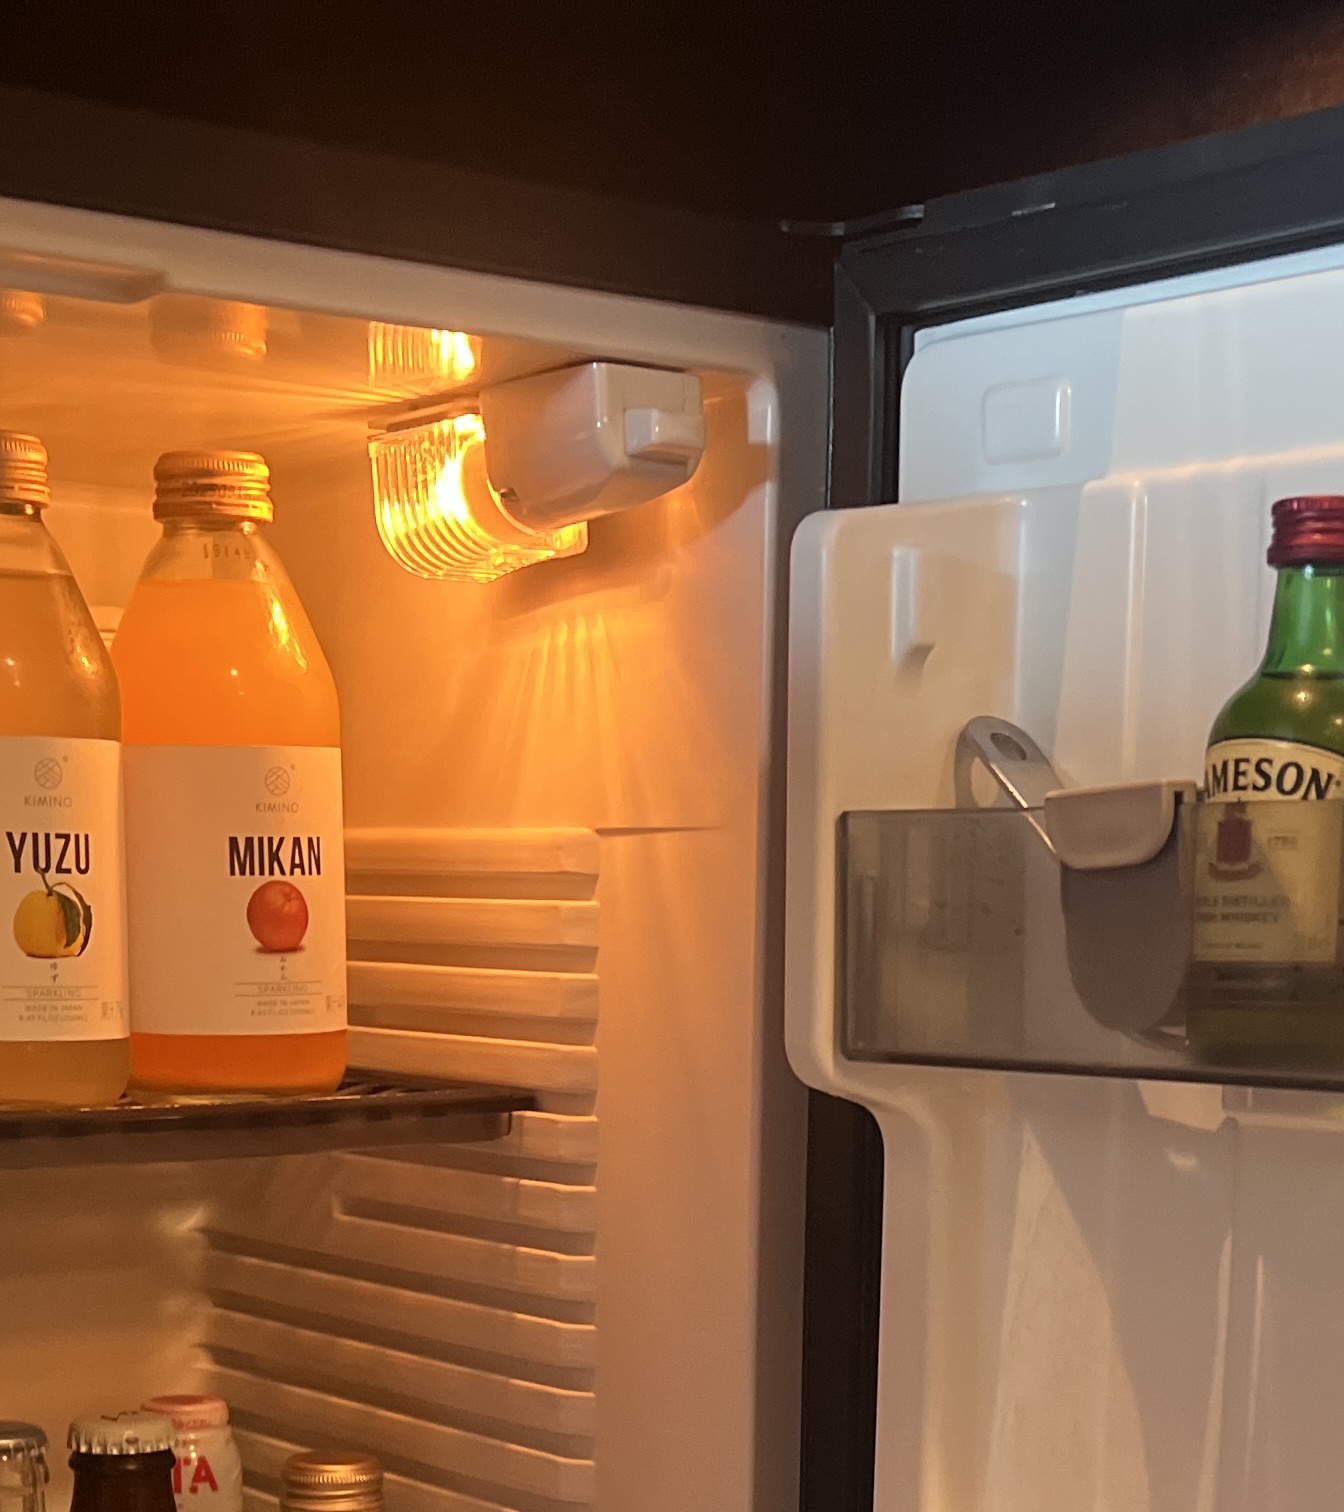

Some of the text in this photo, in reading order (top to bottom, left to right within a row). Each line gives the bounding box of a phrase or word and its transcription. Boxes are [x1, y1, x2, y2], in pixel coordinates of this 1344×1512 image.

[23, 795, 73, 808] KIMINO
[255, 801, 300, 814] KIMINO
[5, 831, 91, 875] YUZU
[228, 836, 322, 877] MIKAN
